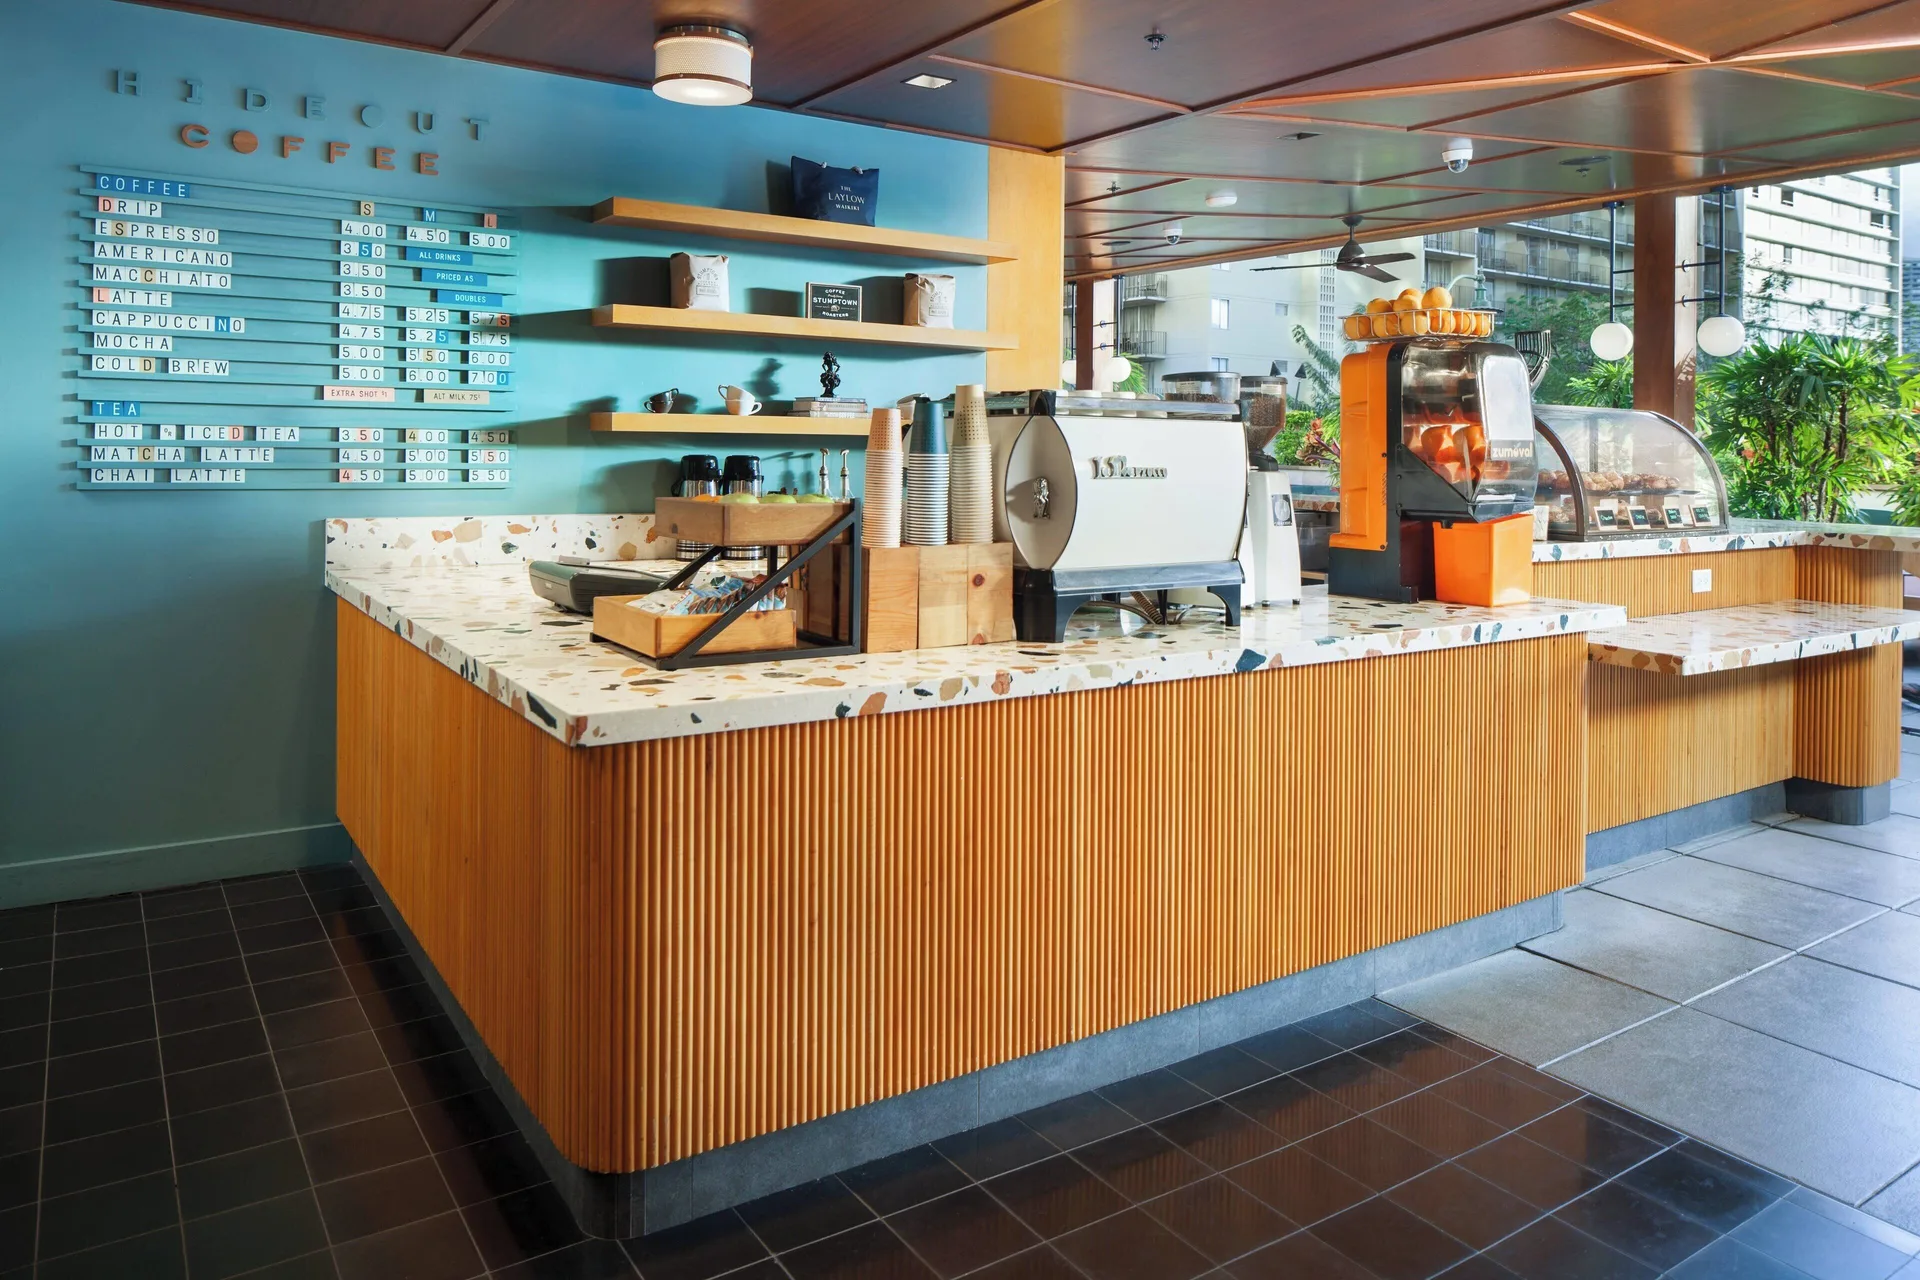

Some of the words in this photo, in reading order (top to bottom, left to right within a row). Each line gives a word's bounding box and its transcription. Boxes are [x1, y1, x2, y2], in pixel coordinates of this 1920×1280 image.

[116, 69, 489, 140] HIDEOUT
[182, 124, 439, 176] COFFEE
[100, 176, 186, 197] COFFEE
[828, 192, 865, 204] LAYLOW
[102, 199, 158, 216] DRIP
[344, 222, 383, 237] 4.00
[409, 228, 447, 243] 4.50
[472, 234, 507, 248] 5.00
[363, 203, 372, 216] S
[425, 210, 435, 221] M
[487, 215, 493, 227] L
[100, 222, 216, 243] ESPRESSO
[343, 243, 382, 257] 3.50
[98, 244, 229, 266] AMERICANO
[343, 263, 383, 277] 3.50
[419, 252, 432, 260] ALL
[435, 253, 461, 262] DRINKS
[95, 266, 228, 287] MACCHIATO
[343, 284, 383, 298] 3.50
[436, 273, 461, 282] PRICED
[97, 290, 167, 305] LATTE
[342, 305, 381, 319] 4.75
[409, 309, 446, 322] 5.25
[472, 312, 508, 325] 5.75
[455, 294, 486, 303] DOUBLES
[813, 297, 857, 305] STUMPTOWN
[96, 312, 241, 331] CAPPUCCINO
[342, 326, 381, 339] 4.75
[409, 329, 446, 342] 5.25
[472, 332, 507, 345] 5.75
[96, 334, 169, 350] MOCHA
[342, 346, 381, 359] 5.00
[409, 349, 446, 362] 5.50
[471, 353, 507, 365] 6.00
[96, 357, 152, 371] COLD
[172, 360, 228, 374] BREW
[342, 367, 381, 380] 5.00
[409, 370, 446, 382] 6.00
[472, 372, 506, 383] 7.00
[331, 390, 355, 398] EXTRA
[359, 390, 378, 398] SHOT
[449, 393, 466, 401] MILK
[96, 402, 137, 416] TEA
[98, 425, 139, 438] HOT
[164, 428, 173, 437] OR
[191, 427, 240, 439] ICED
[260, 428, 296, 440] TEA
[342, 429, 381, 442] 3.50
[408, 431, 445, 442] 4.00
[471, 431, 506, 443] 4.50
[94, 448, 182, 461] MATCHA
[205, 449, 270, 461] LATTE
[342, 450, 381, 462] 4.50
[408, 451, 446, 462] 5.00
[94, 469, 148, 481] CHAI
[175, 469, 241, 482] LATTE
[342, 470, 381, 481] 4.50
[409, 470, 445, 481] 5.00
[472, 470, 507, 481] 550
